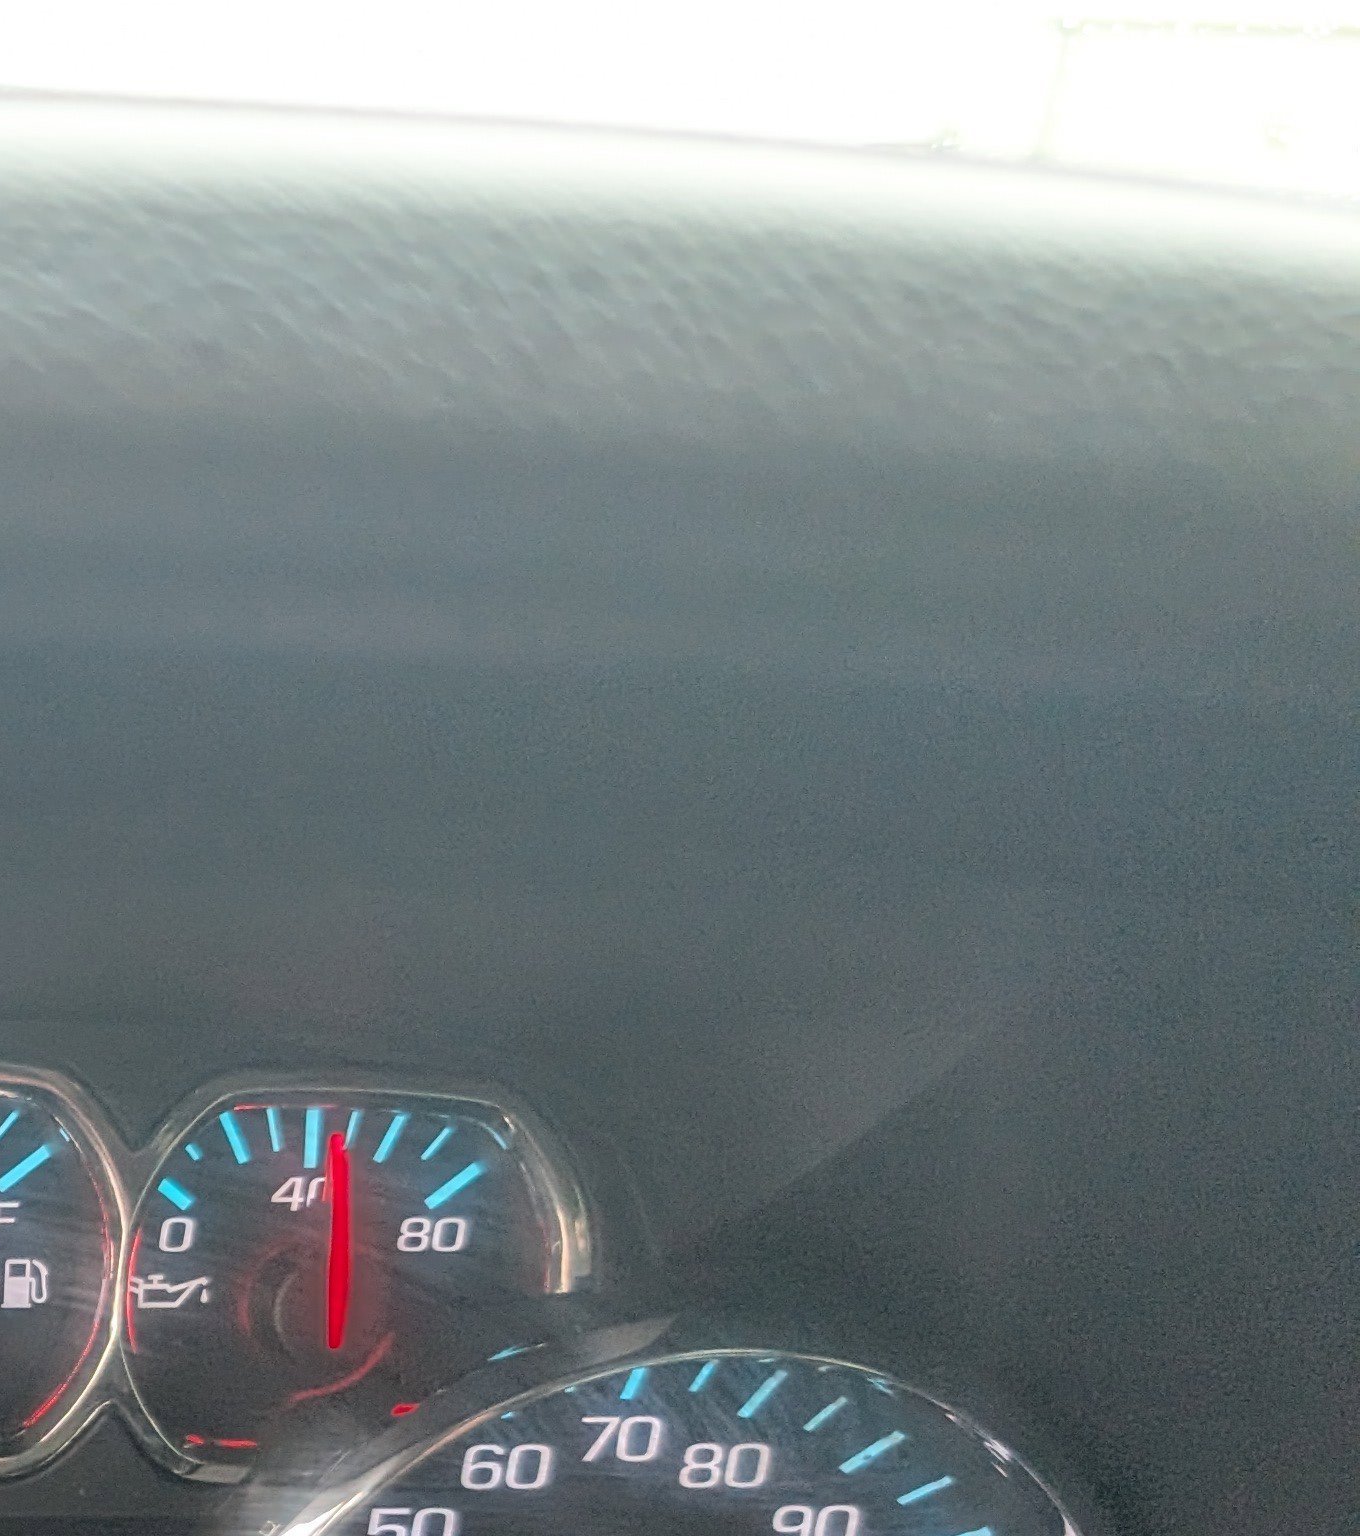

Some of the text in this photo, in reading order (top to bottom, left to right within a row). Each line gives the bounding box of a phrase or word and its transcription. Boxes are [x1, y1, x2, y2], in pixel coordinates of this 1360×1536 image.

[158, 1217, 194, 1253] 0
[396, 1217, 467, 1253] 80
[580, 1415, 663, 1463] 70
[460, 1443, 553, 1490] 60
[678, 1443, 770, 1489] 80
